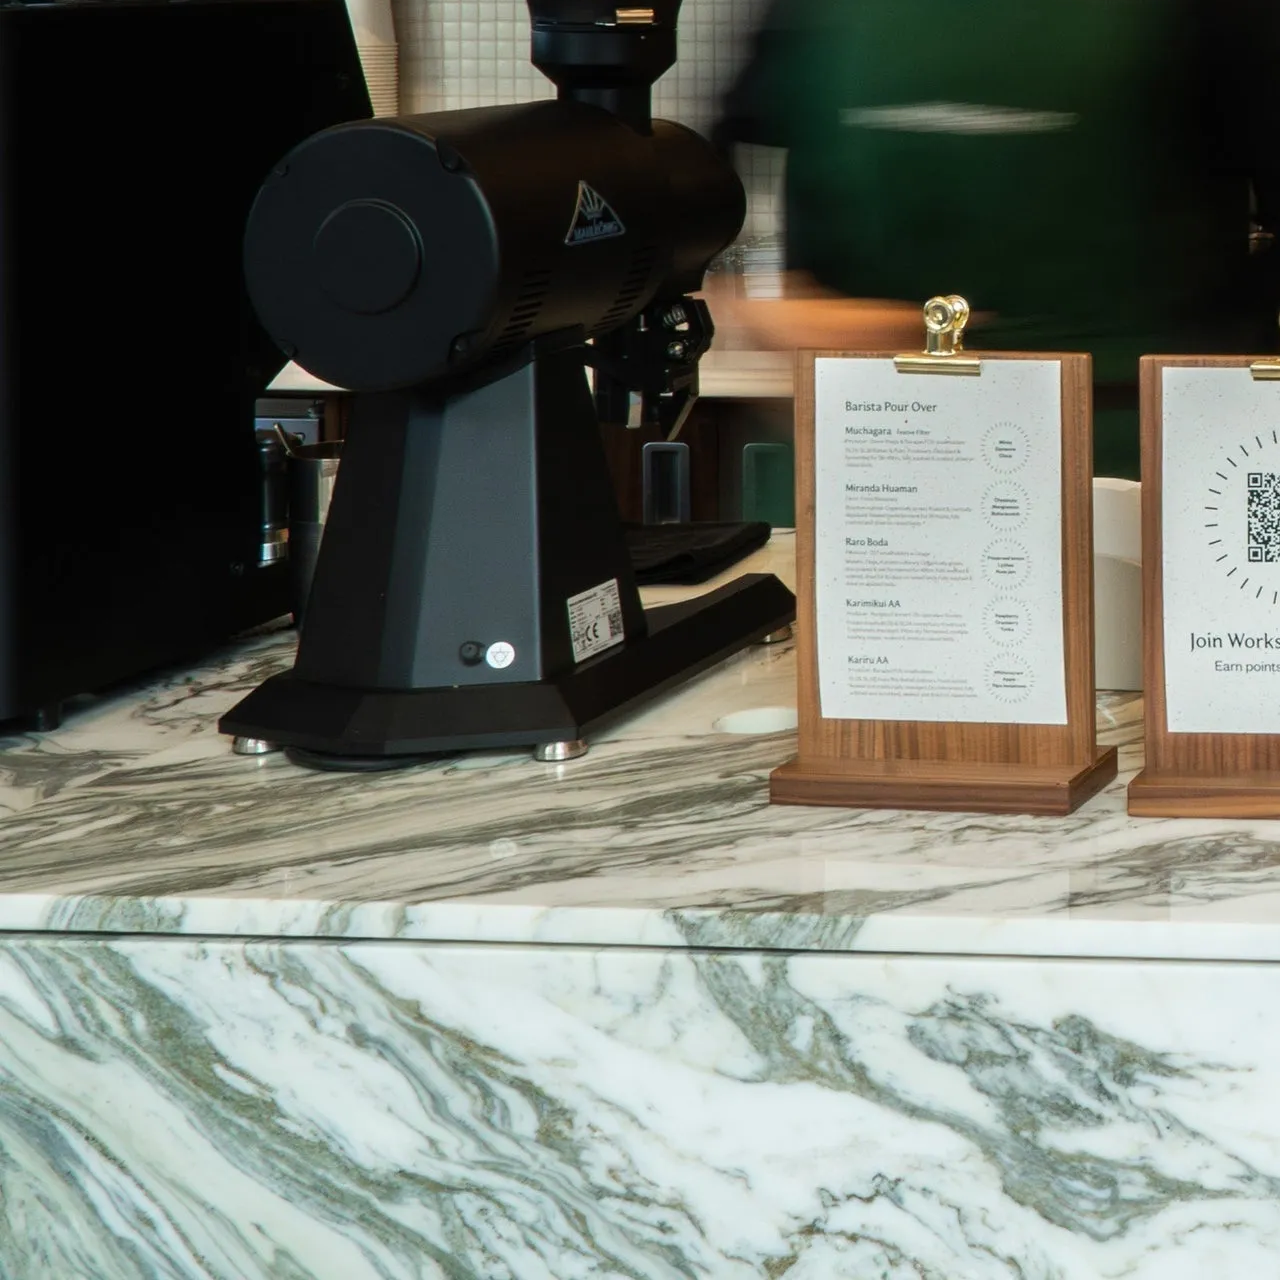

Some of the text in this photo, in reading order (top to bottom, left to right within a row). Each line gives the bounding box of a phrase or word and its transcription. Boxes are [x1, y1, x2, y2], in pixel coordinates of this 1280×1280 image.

[845, 401, 938, 412] Barista Pour Over
[845, 426, 892, 437] Muchagara
[845, 483, 918, 493] Miranda Huaman
[845, 537, 889, 547] Raro Boda
[888, 599, 901, 608] AA
[1190, 632, 1223, 652] Join
[876, 656, 890, 664] AA
[1214, 660, 1243, 672] Earn
